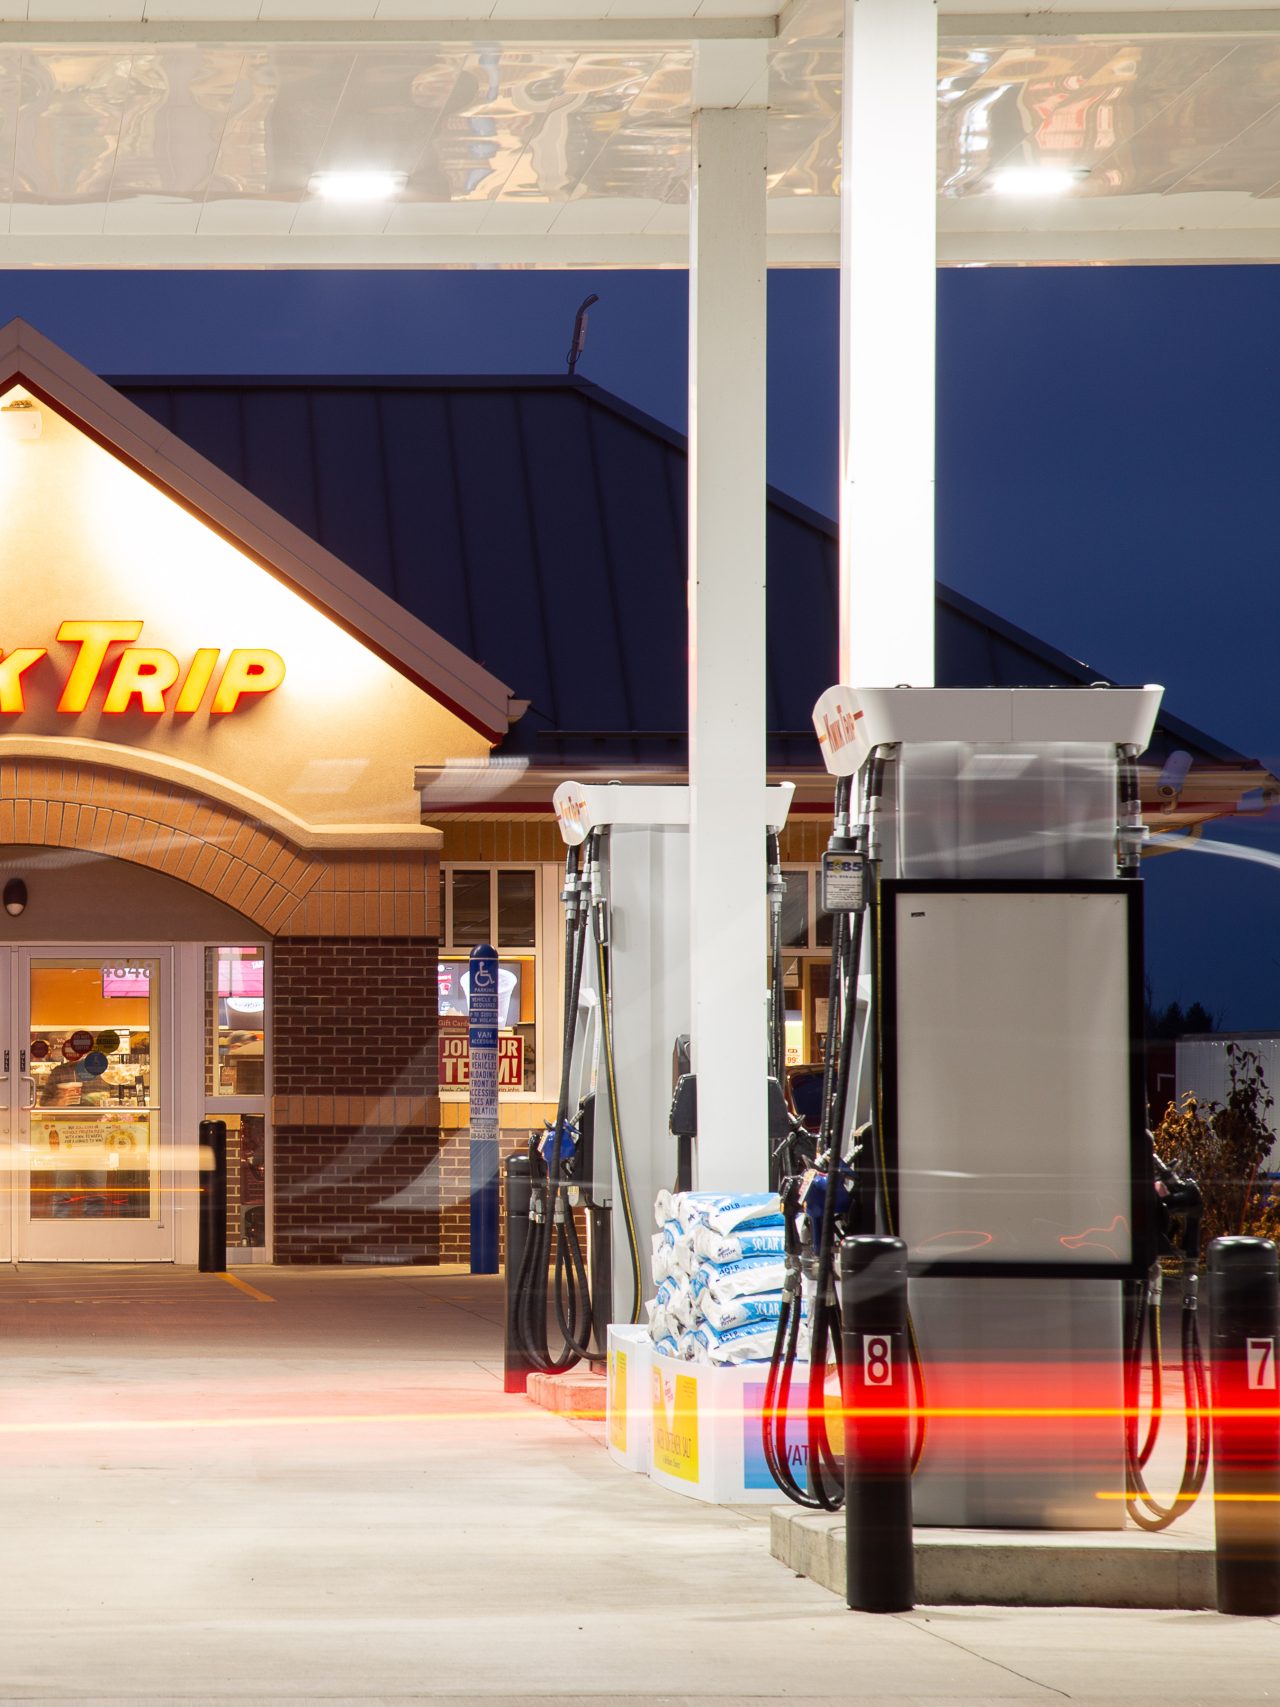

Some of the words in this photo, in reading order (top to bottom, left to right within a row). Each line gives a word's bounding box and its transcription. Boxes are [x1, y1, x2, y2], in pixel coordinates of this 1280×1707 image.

[56, 620, 287, 714] TRIP
[101, 960, 154, 978] 4848
[443, 1039, 469, 1057] JOI
[498, 1039, 519, 1057] UR
[441, 1058, 519, 1084] TEM!
[867, 1338, 889, 1383] 8
[1250, 1341, 1272, 1386] 7
